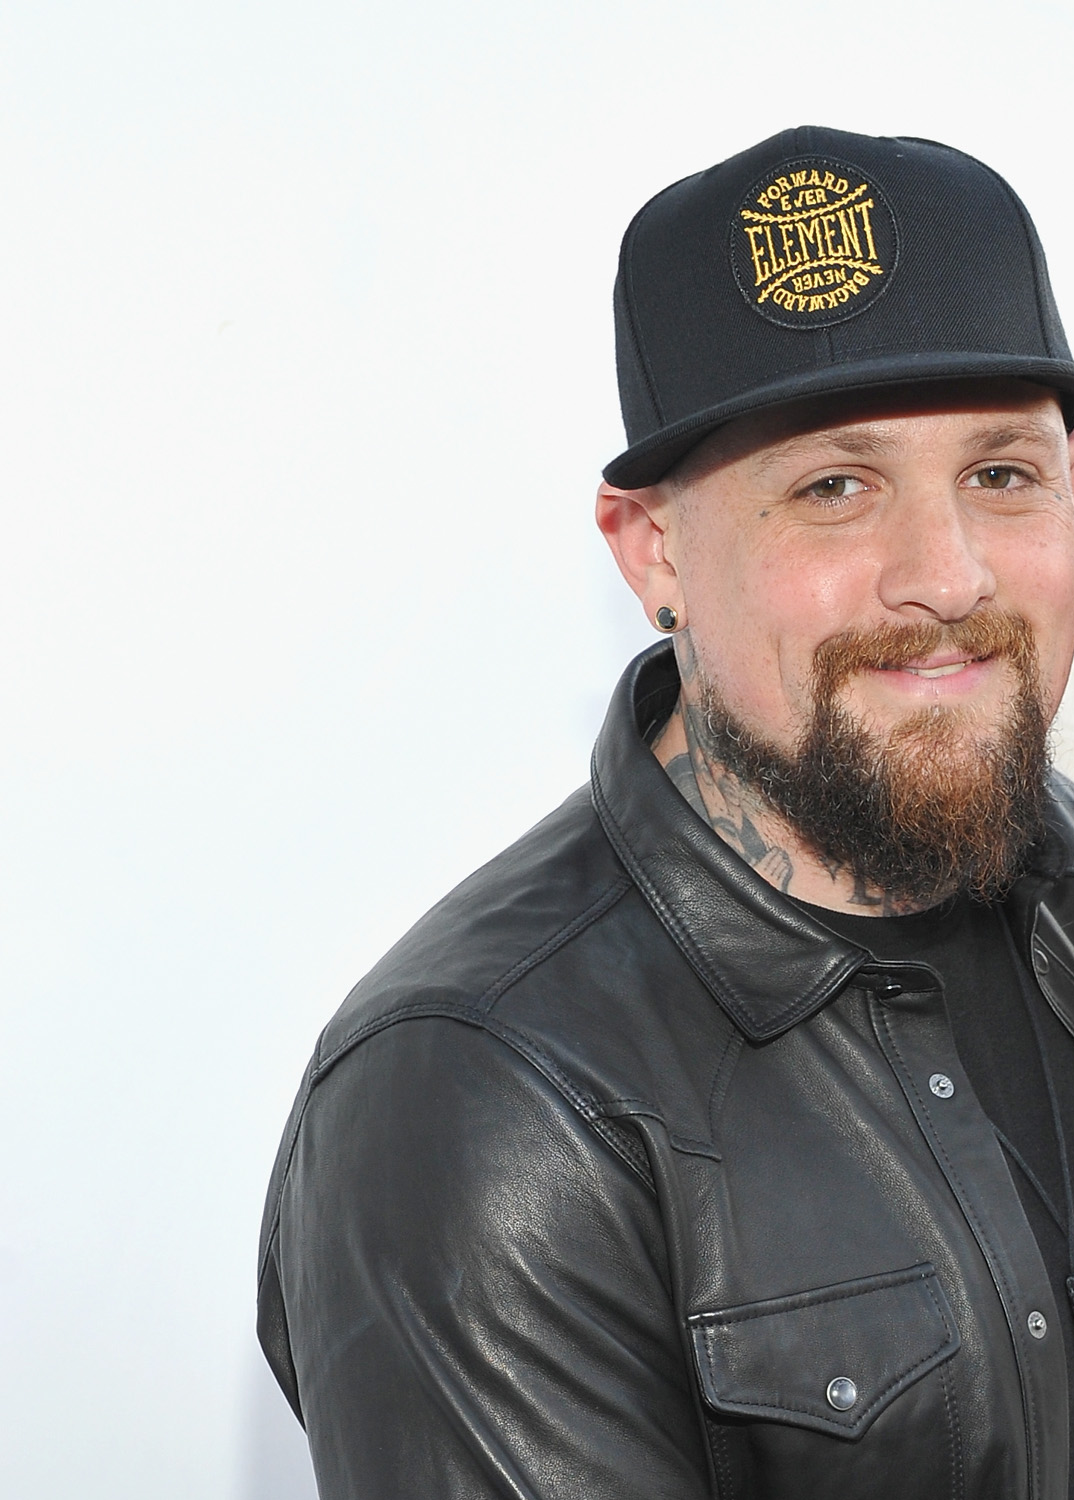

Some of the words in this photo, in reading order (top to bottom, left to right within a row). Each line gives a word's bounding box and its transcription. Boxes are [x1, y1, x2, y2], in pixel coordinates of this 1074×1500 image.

[758, 170, 848, 208] FORWARD
[780, 188, 827, 211] EVER
[745, 199, 877, 286] ELEMENT
[774, 271, 869, 311] BACKWARD
[793, 269, 846, 292] NEVER
